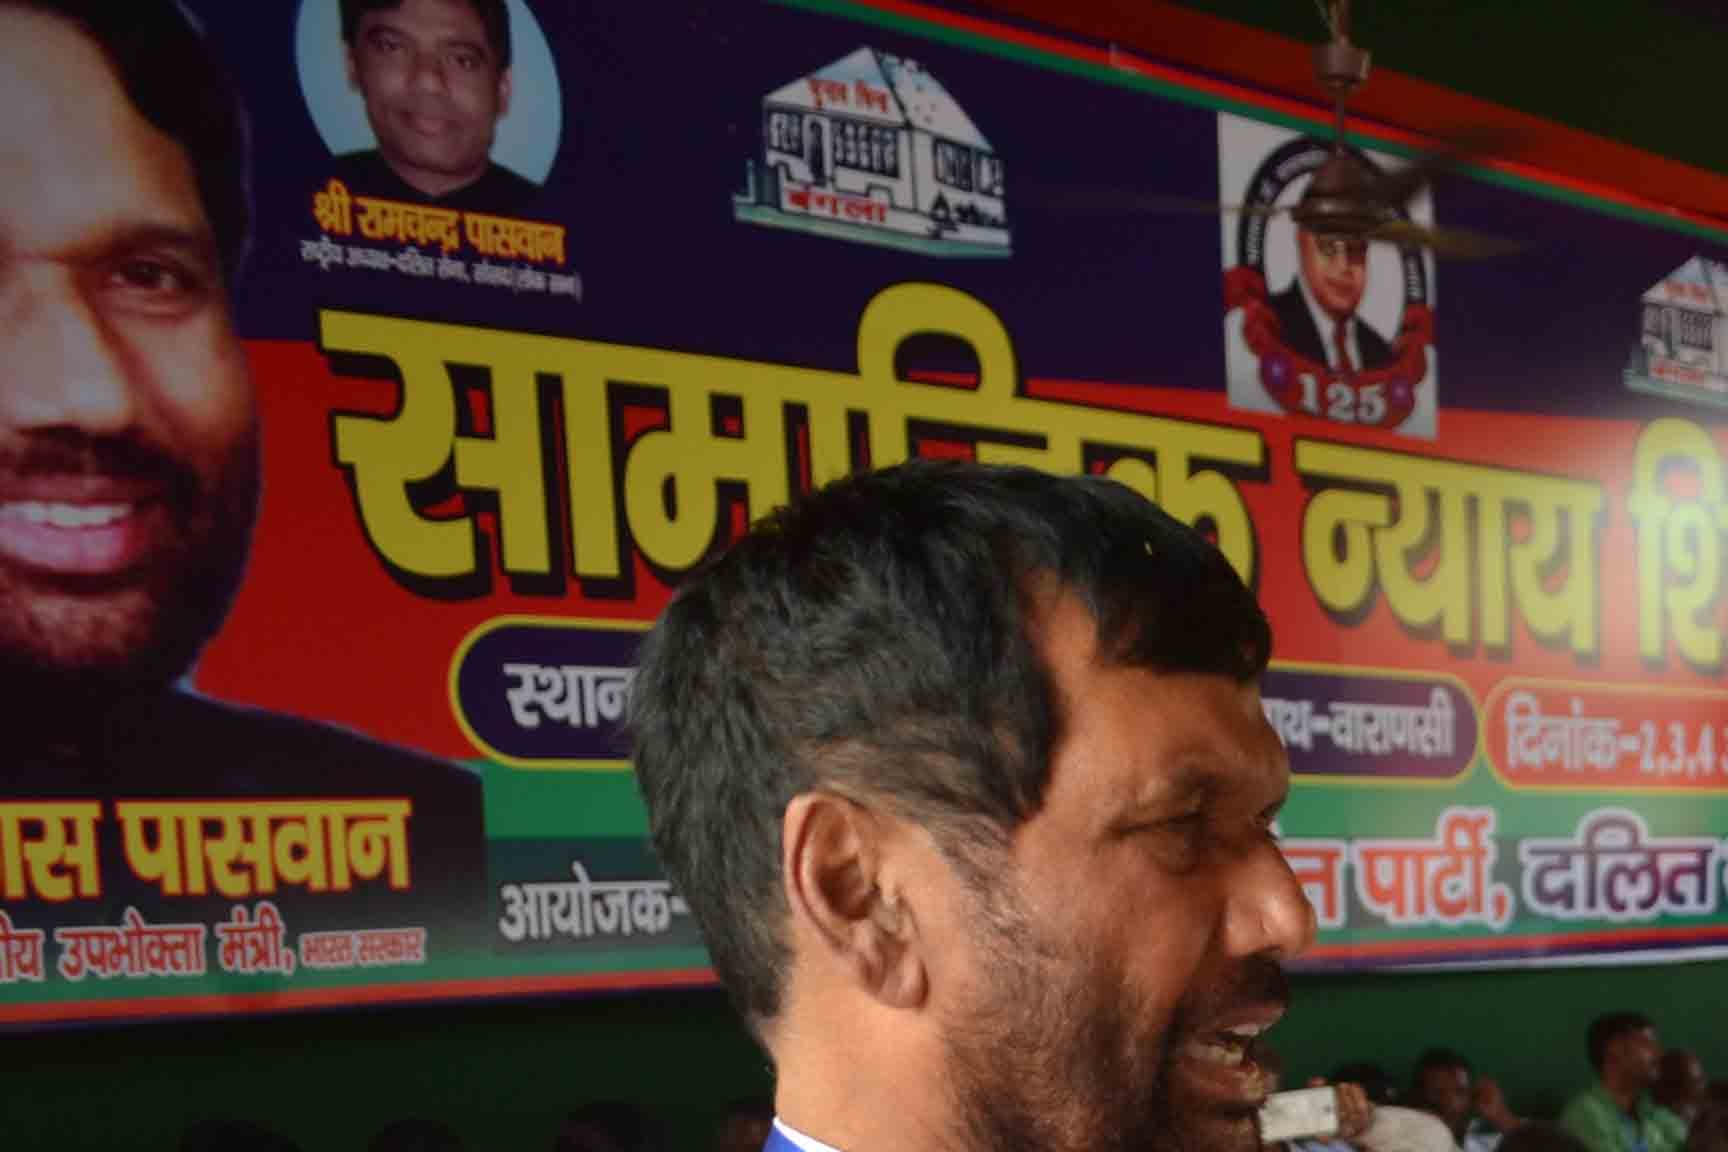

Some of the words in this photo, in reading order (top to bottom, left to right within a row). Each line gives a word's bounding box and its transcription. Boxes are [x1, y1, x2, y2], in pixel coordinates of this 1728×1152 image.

[313, 177, 351, 235] श्री
[461, 211, 565, 265] पासवान
[1298, 373, 1386, 422] 125
[1296, 437, 1606, 656] न्याय
[115, 799, 412, 897] पासवान
[1359, 809, 1511, 930] पार्टी,
[1520, 807, 1717, 920] दलित
[55, 906, 207, 979] उपभोक्ता
[215, 902, 296, 976] मंत्री,
